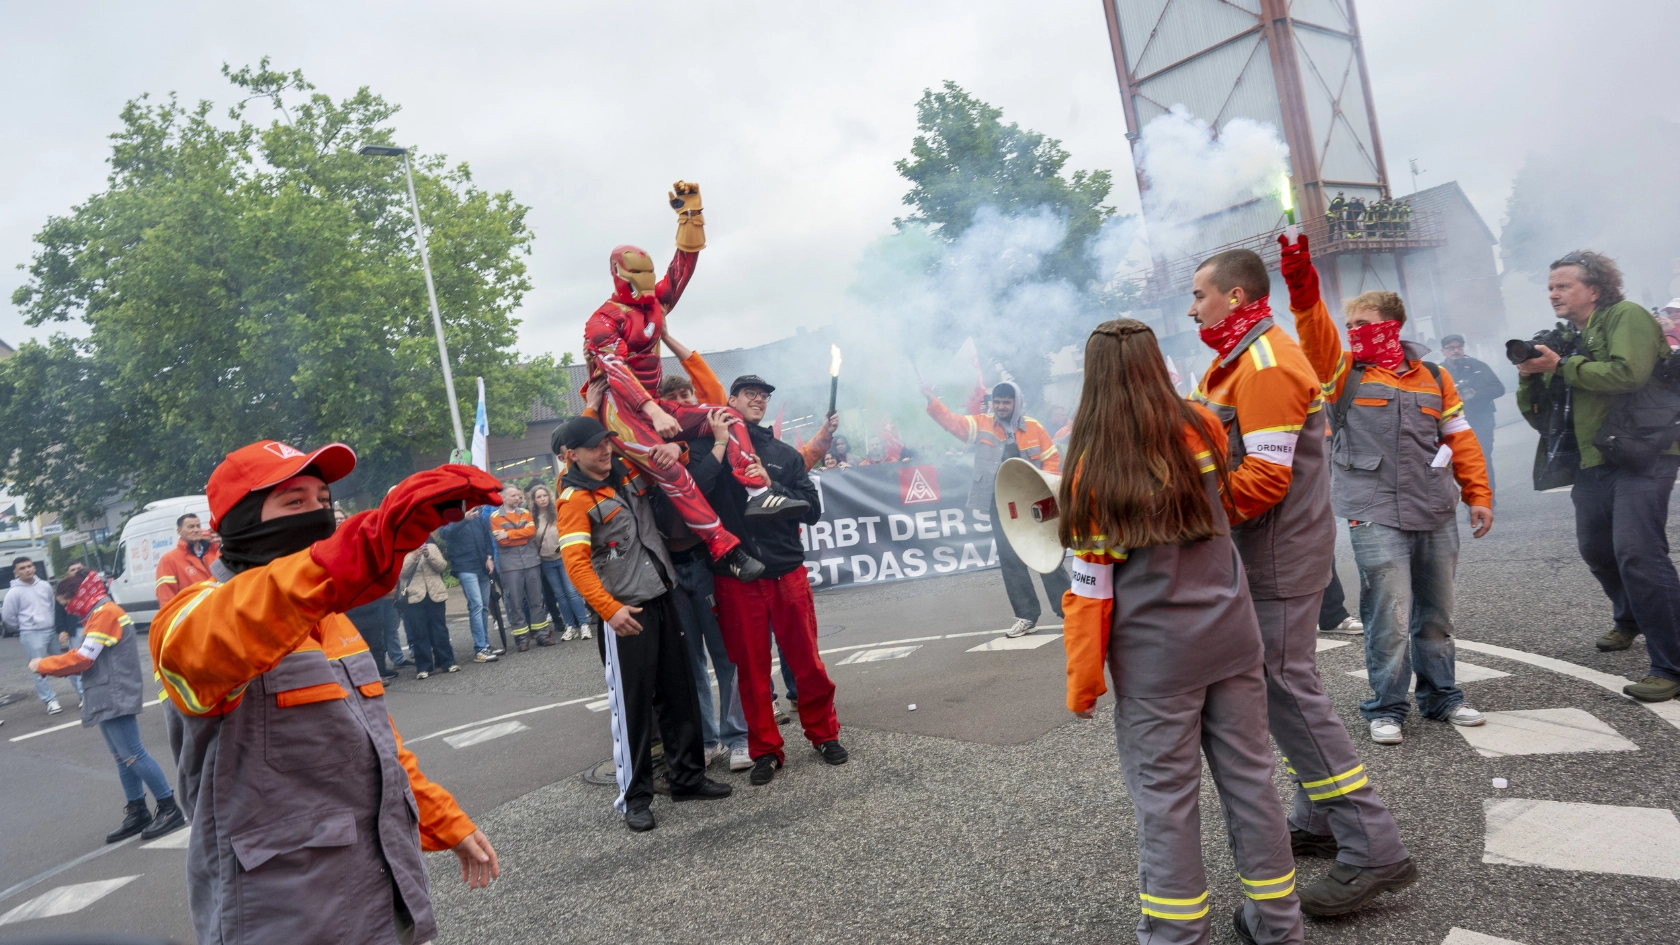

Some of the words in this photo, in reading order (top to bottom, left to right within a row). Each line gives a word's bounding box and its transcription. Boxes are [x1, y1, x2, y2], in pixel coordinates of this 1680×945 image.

[1257, 444, 1292, 453] ORDNER
[888, 508, 967, 541] DER
[851, 548, 928, 583] DAS
[1073, 570, 1096, 586] RDNER
